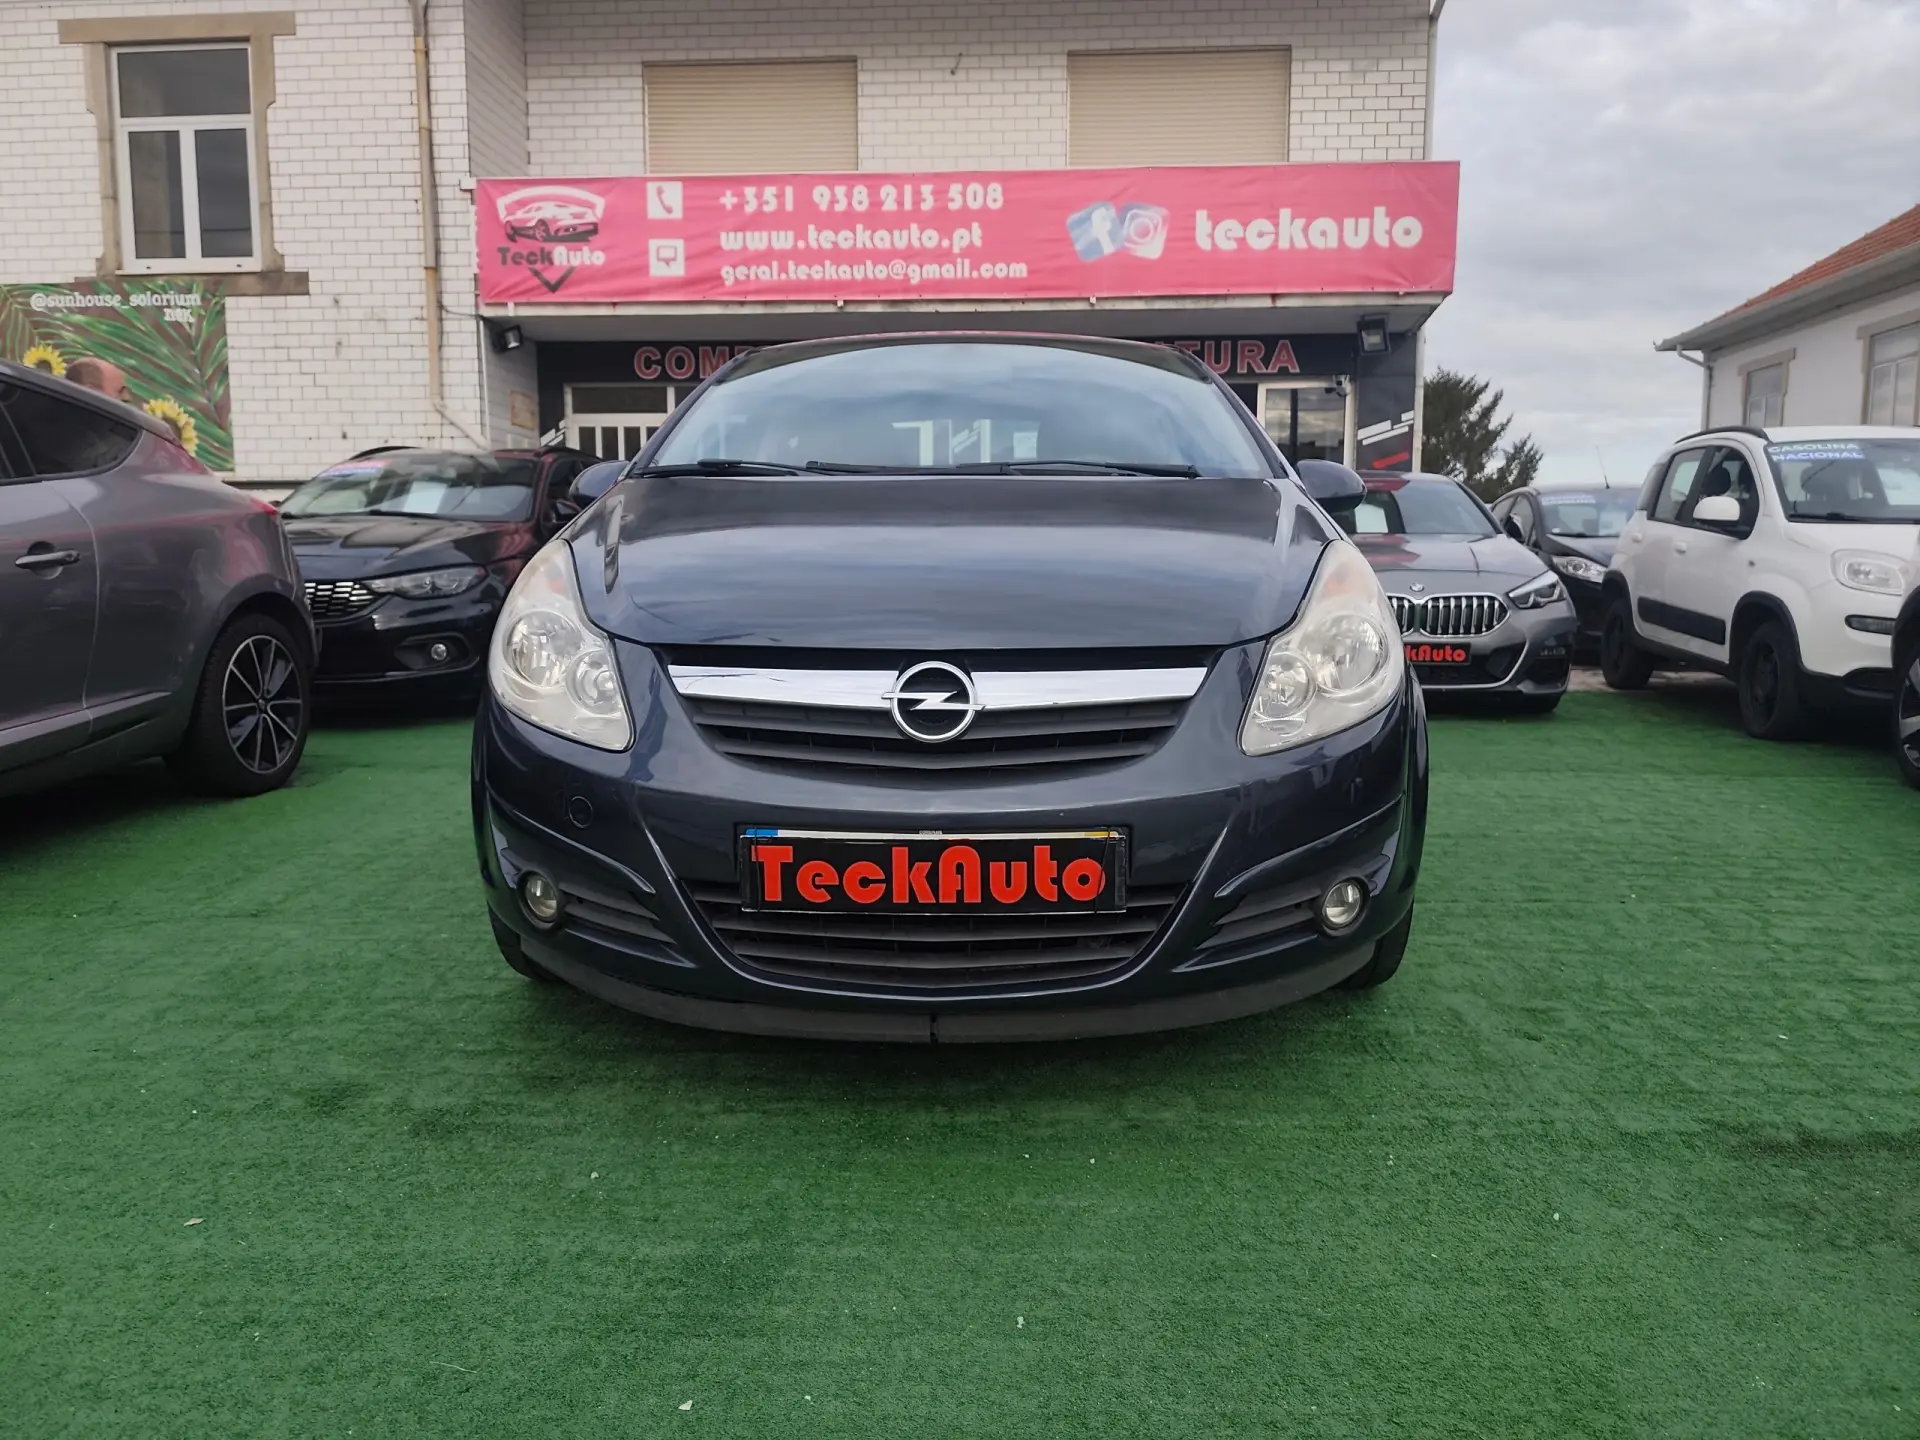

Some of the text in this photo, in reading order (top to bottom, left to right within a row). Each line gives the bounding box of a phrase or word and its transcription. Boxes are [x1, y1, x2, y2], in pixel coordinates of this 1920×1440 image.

[719, 182, 1004, 213] +351 938 213 508
[719, 222, 983, 253] www.teckauto.pt
[1195, 206, 1423, 251] teckauto
[497, 245, 605, 267] TeckAuto
[720, 258, 1028, 286] geral.teckauto@gmail.com
[29, 291, 202, 311] @sunhouse_solarium
[633, 346, 755, 379] COM
[751, 845, 1106, 903] TeckAuto
